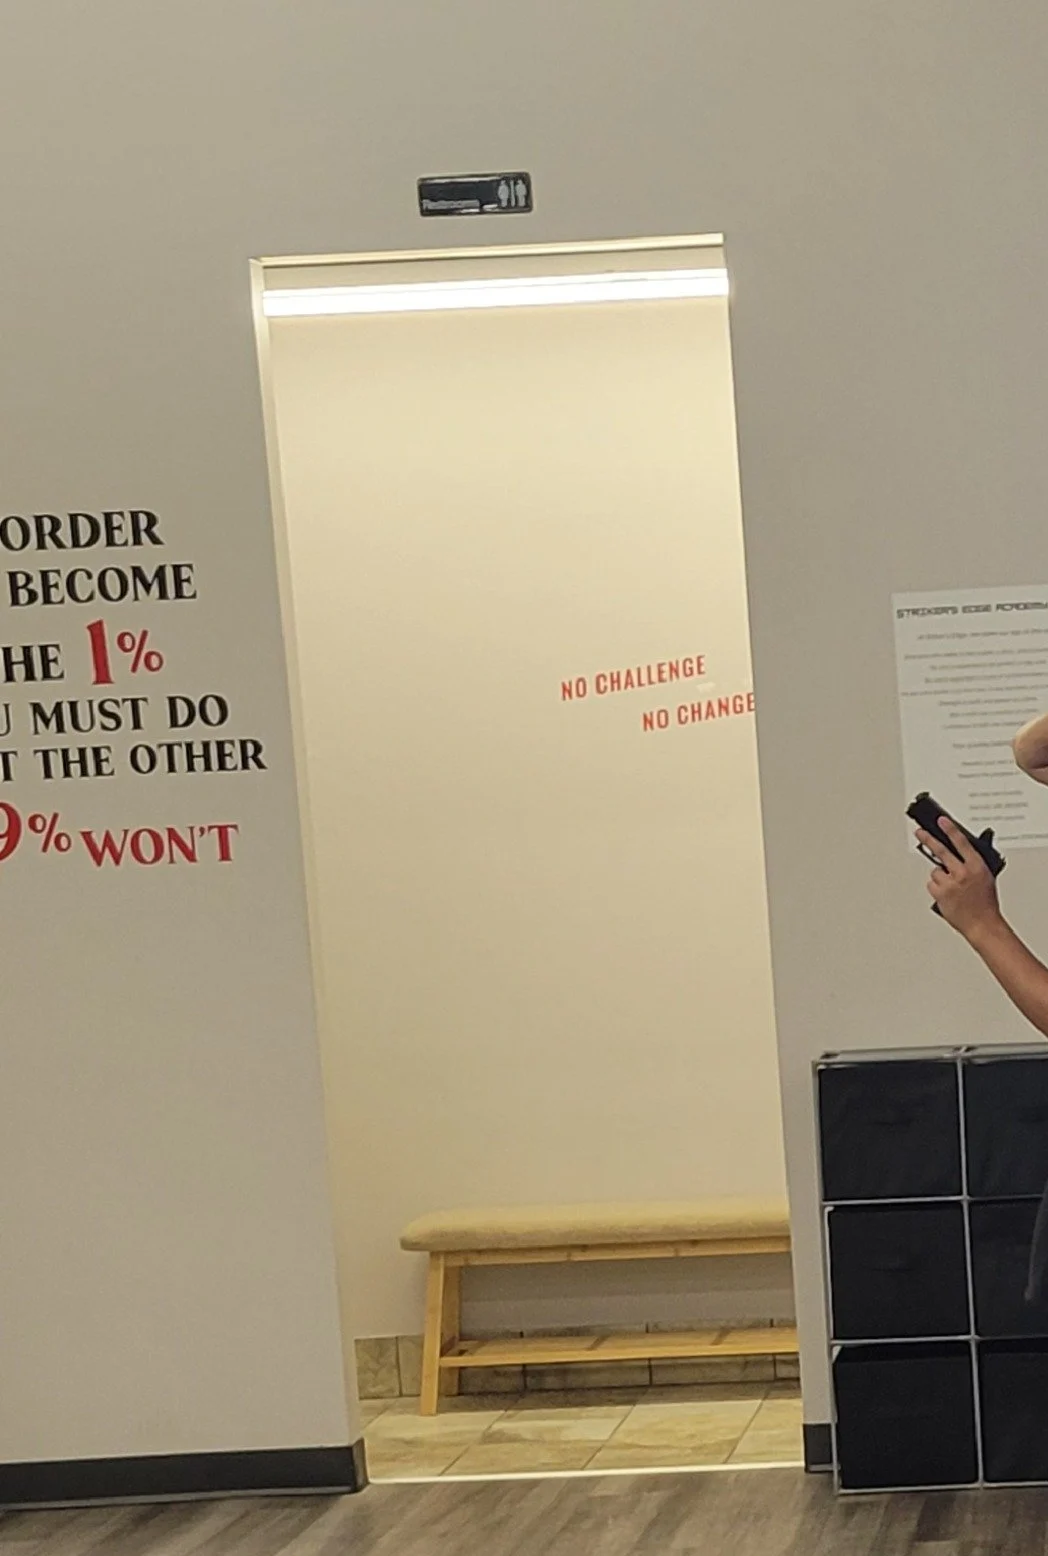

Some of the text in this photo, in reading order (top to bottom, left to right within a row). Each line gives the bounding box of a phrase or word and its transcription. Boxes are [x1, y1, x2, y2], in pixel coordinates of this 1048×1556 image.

[0, 510, 164, 551] ORDER
[7, 563, 198, 607] BECOME
[86, 619, 164, 685] 1%
[561, 655, 706, 701] NO CHALLENGE
[30, 697, 149, 735] MUST
[167, 694, 229, 728] DO
[643, 692, 755, 732] NO CHANGE
[33, 745, 115, 780] THE
[129, 738, 268, 775] OTHER
[80, 824, 239, 867] WON'T
